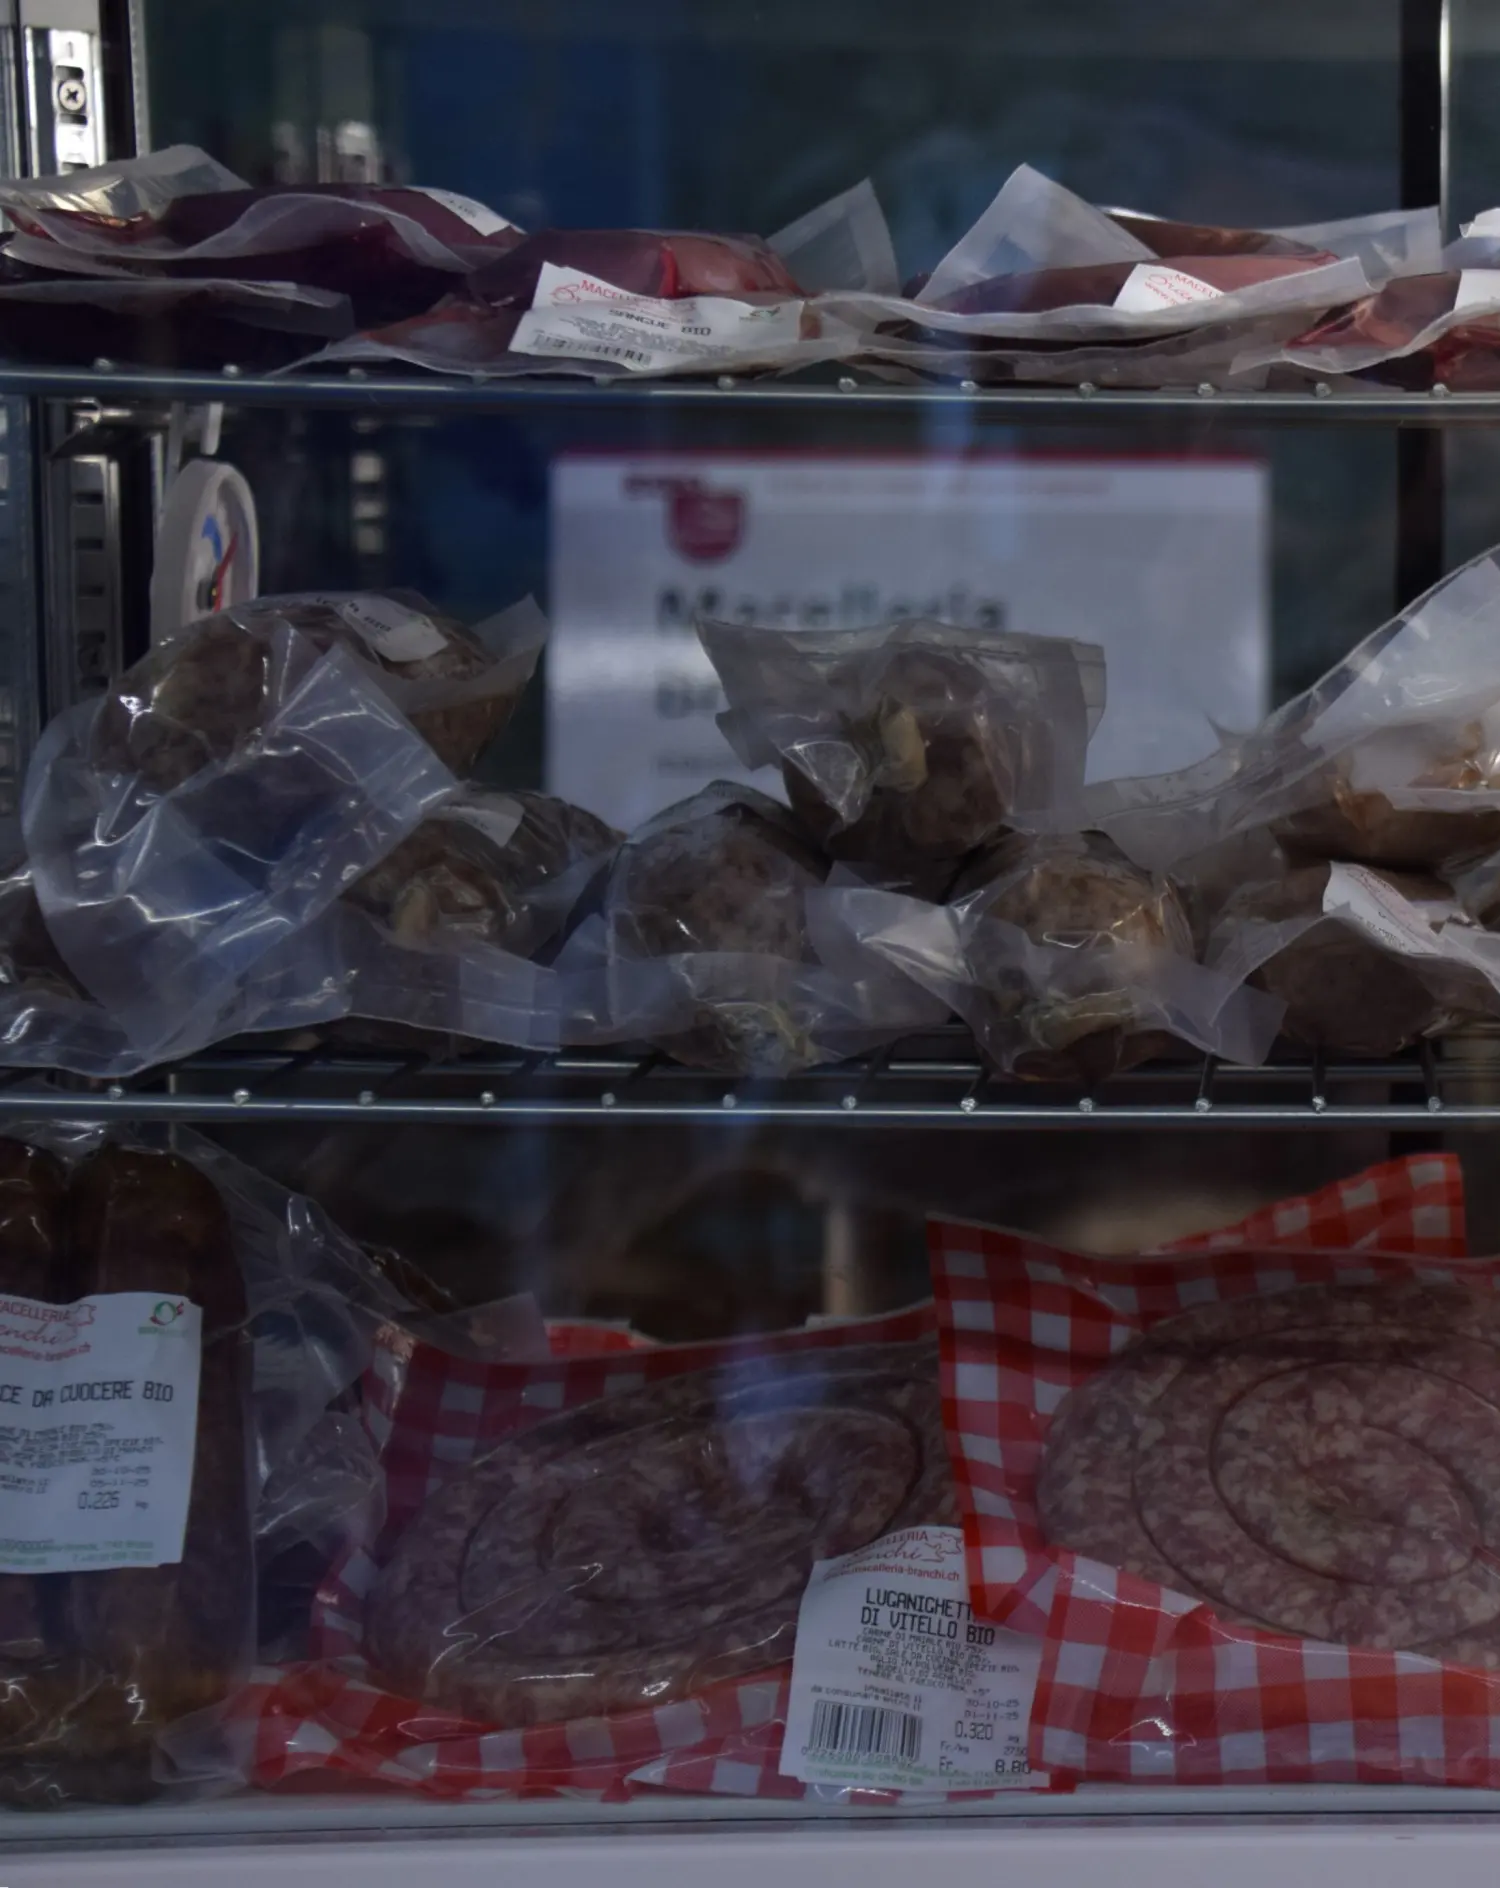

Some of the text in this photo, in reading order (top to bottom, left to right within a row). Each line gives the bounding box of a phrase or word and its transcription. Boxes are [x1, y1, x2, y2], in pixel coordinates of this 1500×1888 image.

[609, 309, 670, 330] SANGUE
[32, 1390, 54, 1408] DA
[60, 1380, 134, 1404] CUOCERE
[142, 1380, 173, 1402] BIO
[861, 1606, 995, 1646] DI VITELLO BIO
[955, 1720, 993, 1740] 0.320
[995, 1758, 1032, 1775] 8.80
